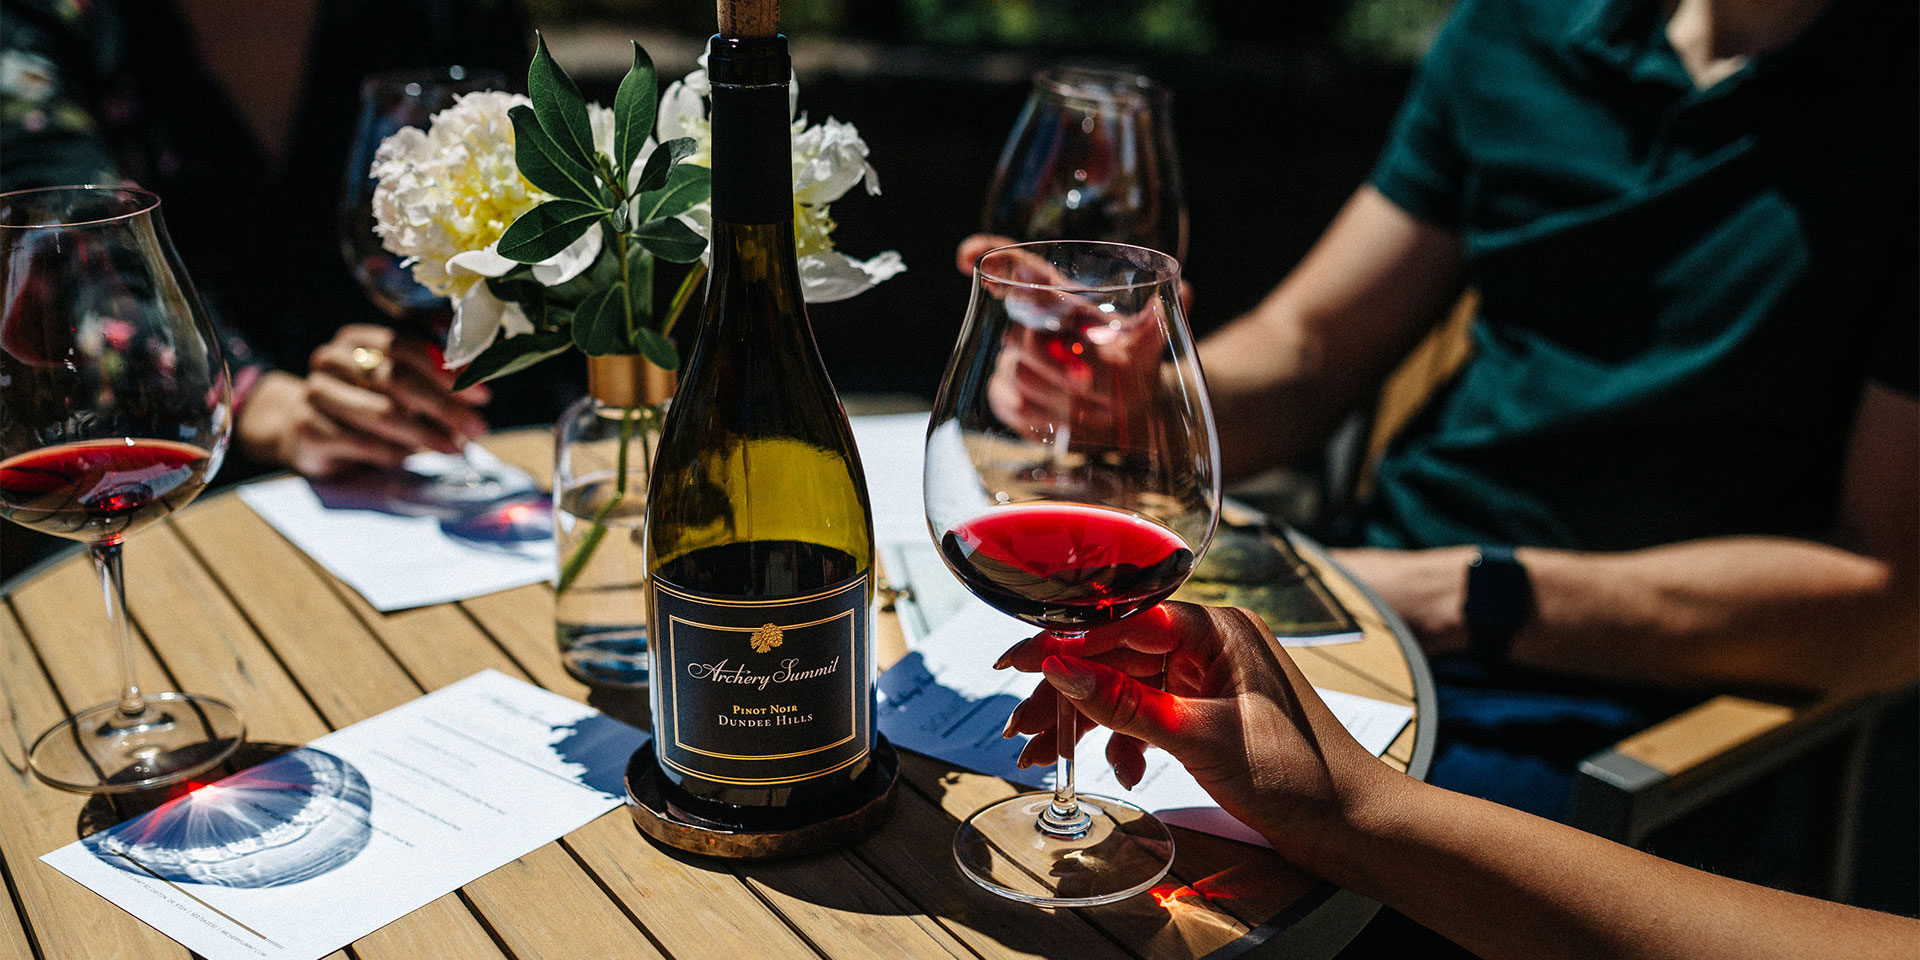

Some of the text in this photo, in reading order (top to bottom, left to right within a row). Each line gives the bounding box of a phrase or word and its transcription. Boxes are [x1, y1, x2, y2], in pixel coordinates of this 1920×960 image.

[687, 655, 840, 691] Archery Summit
[732, 704, 798, 715] PINOT NOIR
[718, 713, 813, 728] DUNDEE HILLS
